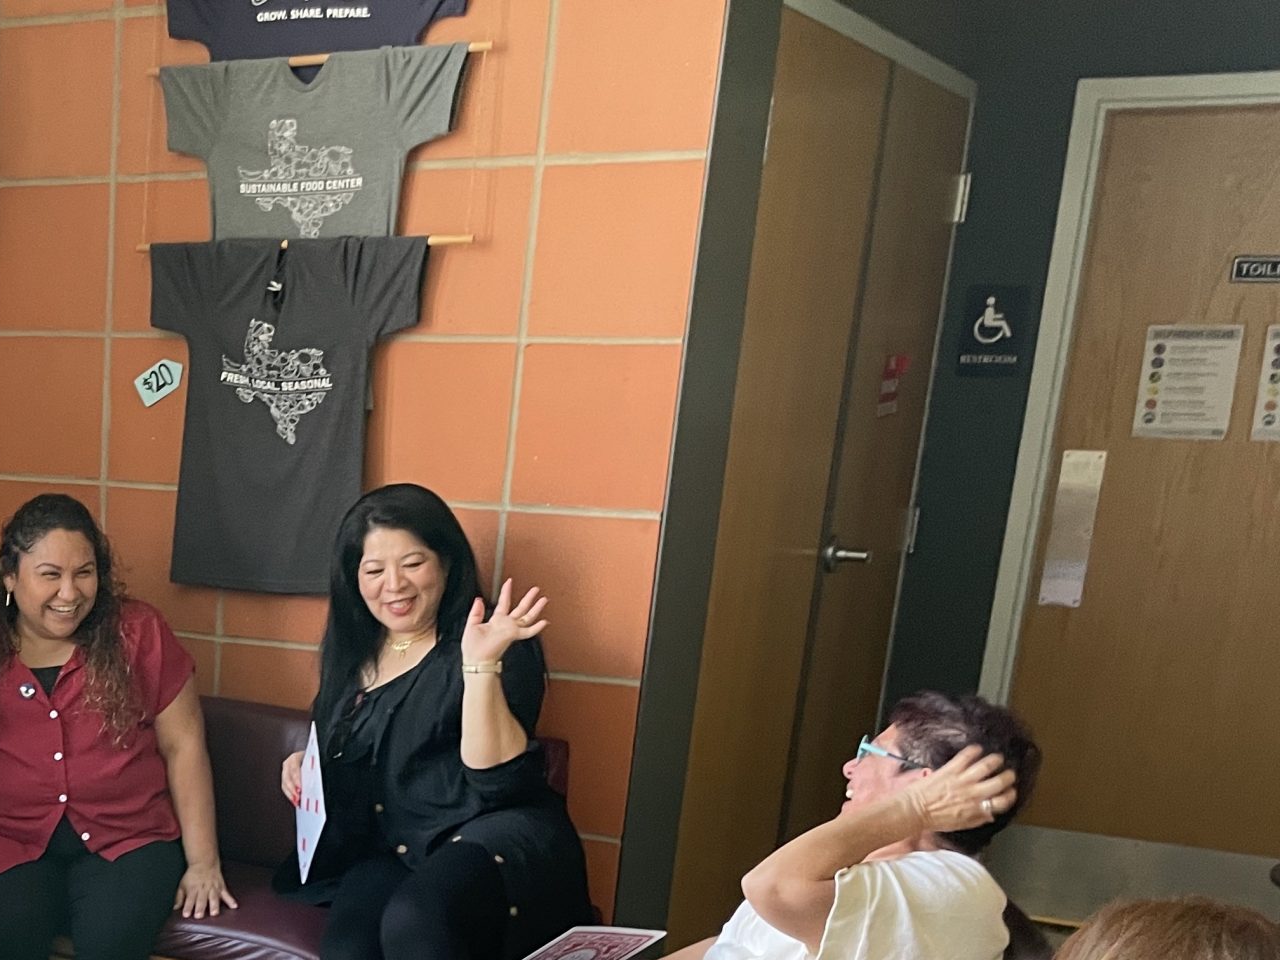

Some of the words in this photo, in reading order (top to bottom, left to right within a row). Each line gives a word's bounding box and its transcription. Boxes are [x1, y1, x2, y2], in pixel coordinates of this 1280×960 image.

[257, 10, 287, 22] GROW.
[327, 7, 371, 18] PREPARE.
[240, 182, 299, 194] SUSTAINABLE
[300, 180, 324, 191] FOOD
[326, 177, 363, 190] CENTER
[1240, 262, 1280, 276] TOIL
[143, 363, 173, 392] $20
